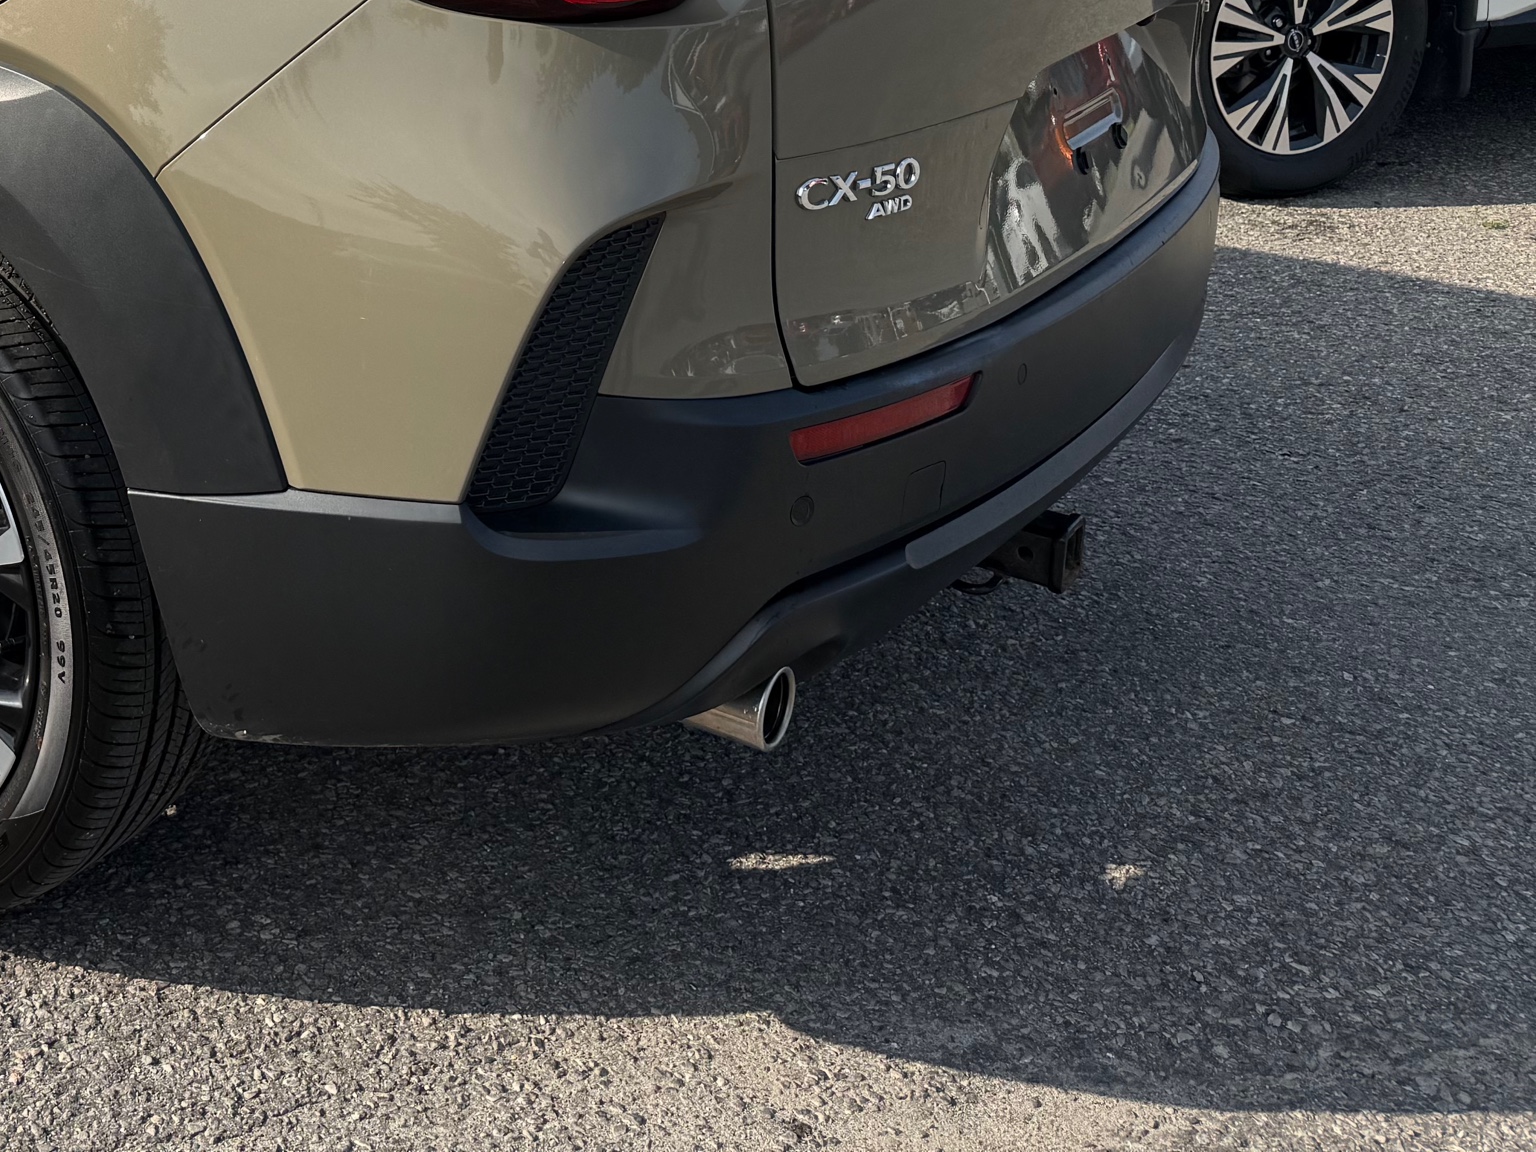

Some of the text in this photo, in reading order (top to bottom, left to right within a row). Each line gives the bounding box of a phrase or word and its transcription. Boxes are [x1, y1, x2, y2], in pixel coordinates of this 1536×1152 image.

[795, 156, 921, 212] CX-50
[865, 194, 913, 220] AWD
[22, 491, 63, 618] 245/45R20
[56, 640, 66, 684] 99V
